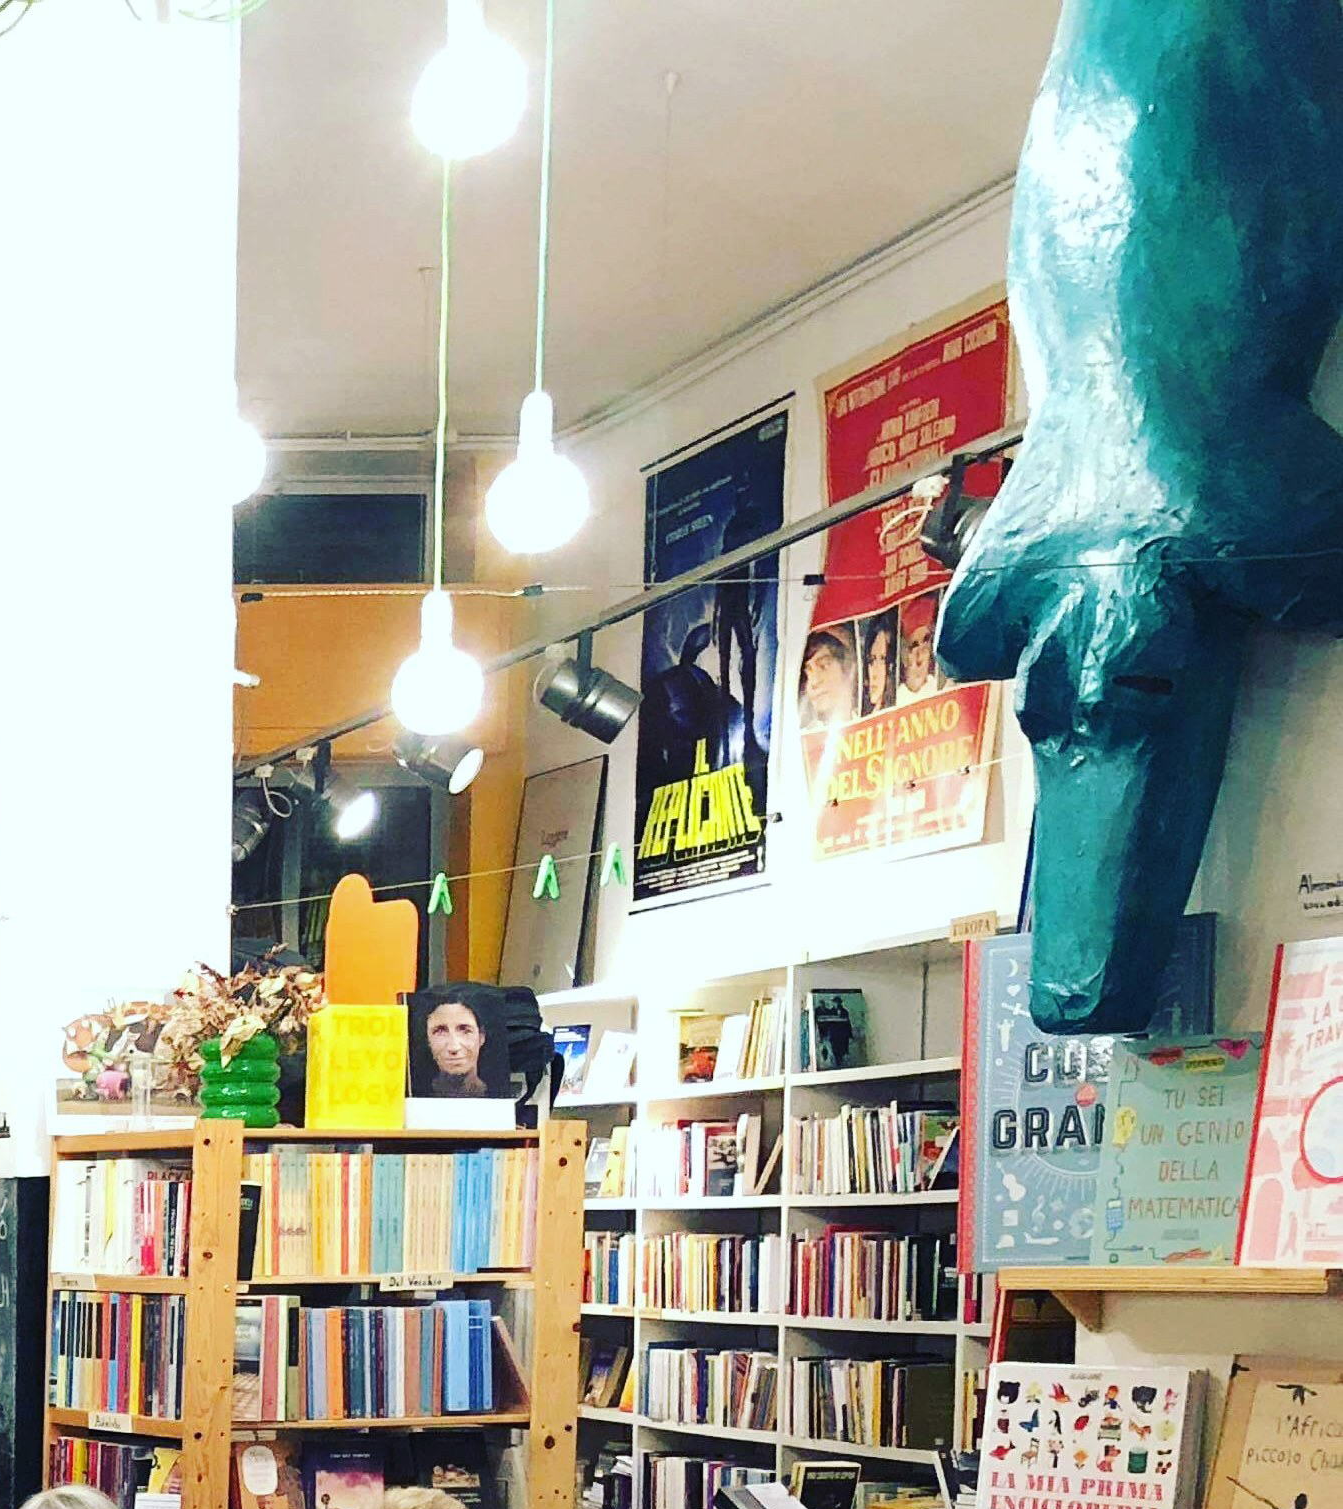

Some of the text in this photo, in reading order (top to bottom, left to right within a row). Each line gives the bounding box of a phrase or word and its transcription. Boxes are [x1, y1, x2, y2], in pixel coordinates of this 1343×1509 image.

[694, 738, 710, 775] IL
[637, 762, 762, 860] REPLICANTE
[331, 1015, 401, 1036] TROL
[330, 1050, 401, 1070] LEYO
[329, 1083, 401, 1105] LOGY
[1164, 1085, 1226, 1109] TU SEI
[1141, 1118, 1245, 1146] UN GENIO
[1158, 1160, 1219, 1183] DELLA
[990, 1471, 1164, 1501] LA MIA PRIMA
